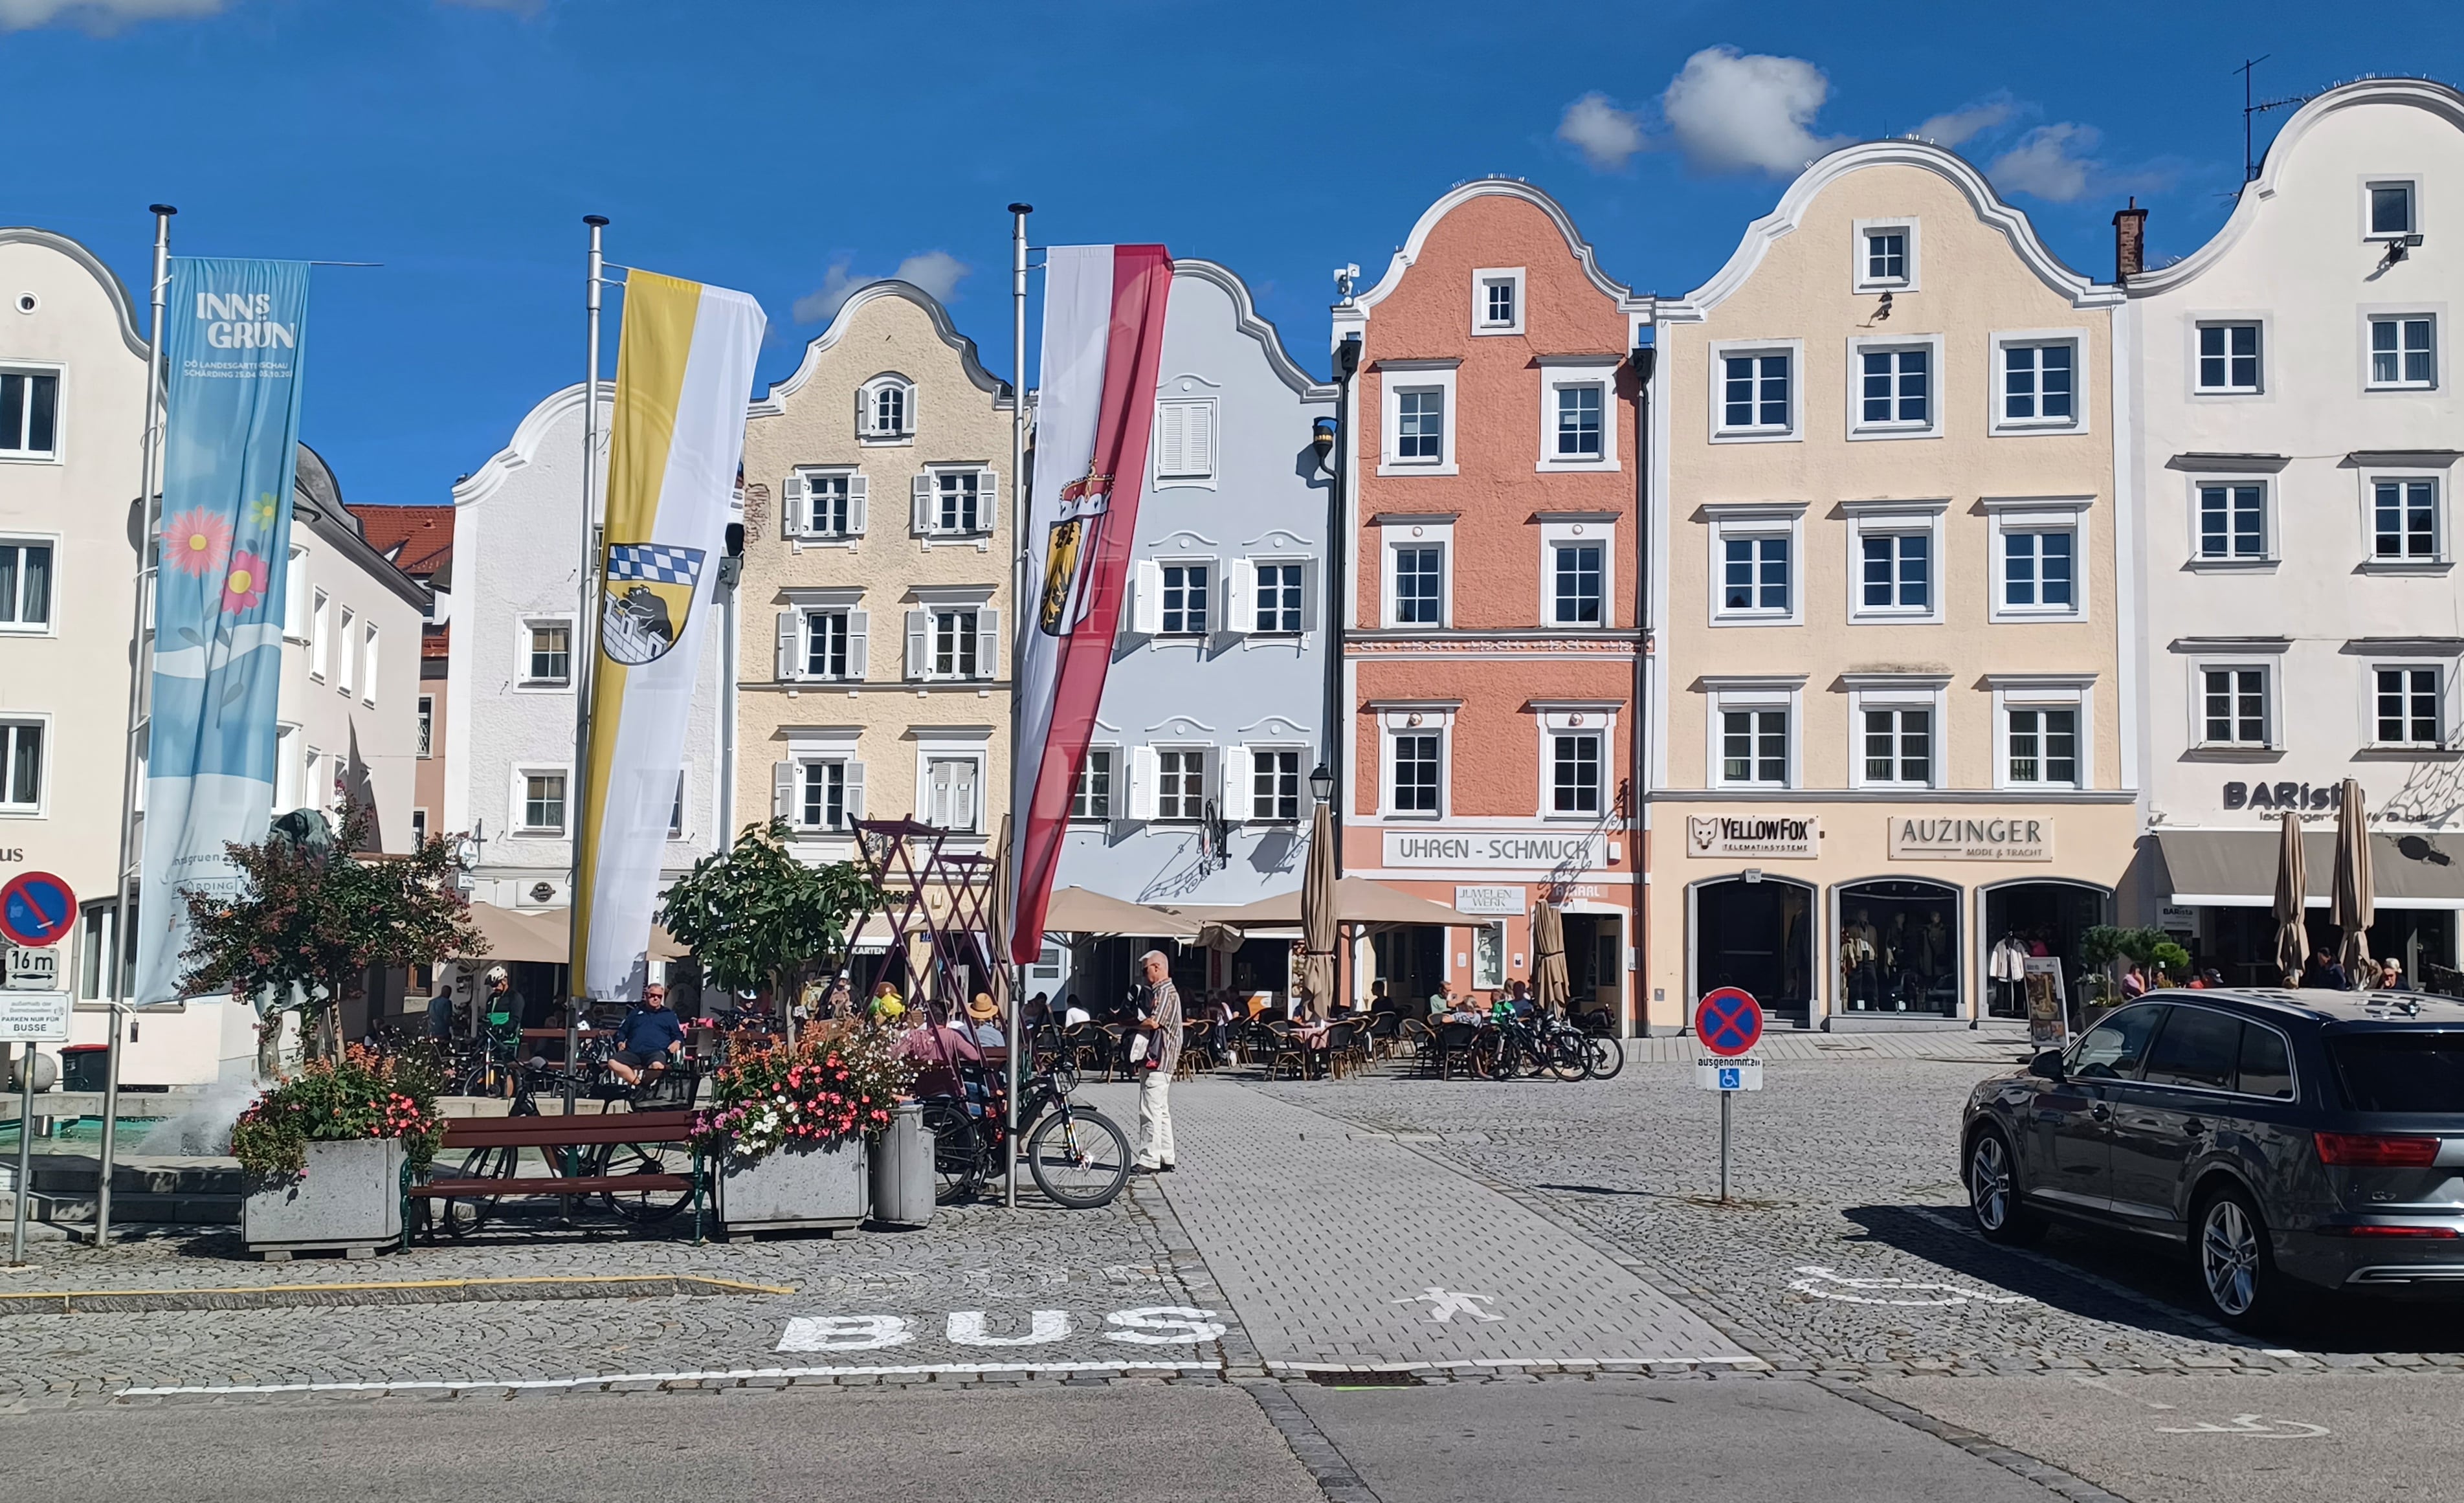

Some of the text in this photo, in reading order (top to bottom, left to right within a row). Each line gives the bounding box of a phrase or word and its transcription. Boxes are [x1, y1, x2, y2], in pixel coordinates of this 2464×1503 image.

[197, 292, 271, 320] INNS
[207, 315, 294, 349] GRÜN
[199, 361, 288, 370] LANDESGARTSCHAU
[184, 369, 234, 378] SCHÄRDING
[2223, 781, 2366, 810] BARist
[1901, 819, 2042, 842] AUZINGER
[1400, 839, 1470, 859] UHREN
[1489, 840, 1590, 860] SCHMUCK
[1997, 849, 2003, 858] &
[1459, 889, 1512, 898] JUWELEN
[1472, 898, 1505, 907] WERK
[12, 950, 53, 971] 16 m
[14, 1023, 47, 1032] BUSSE
[1698, 1058, 1760, 1069] ausgenommen
[2371, 1190, 2397, 1201] Q7
[775, 1306, 1228, 1353] BUS
